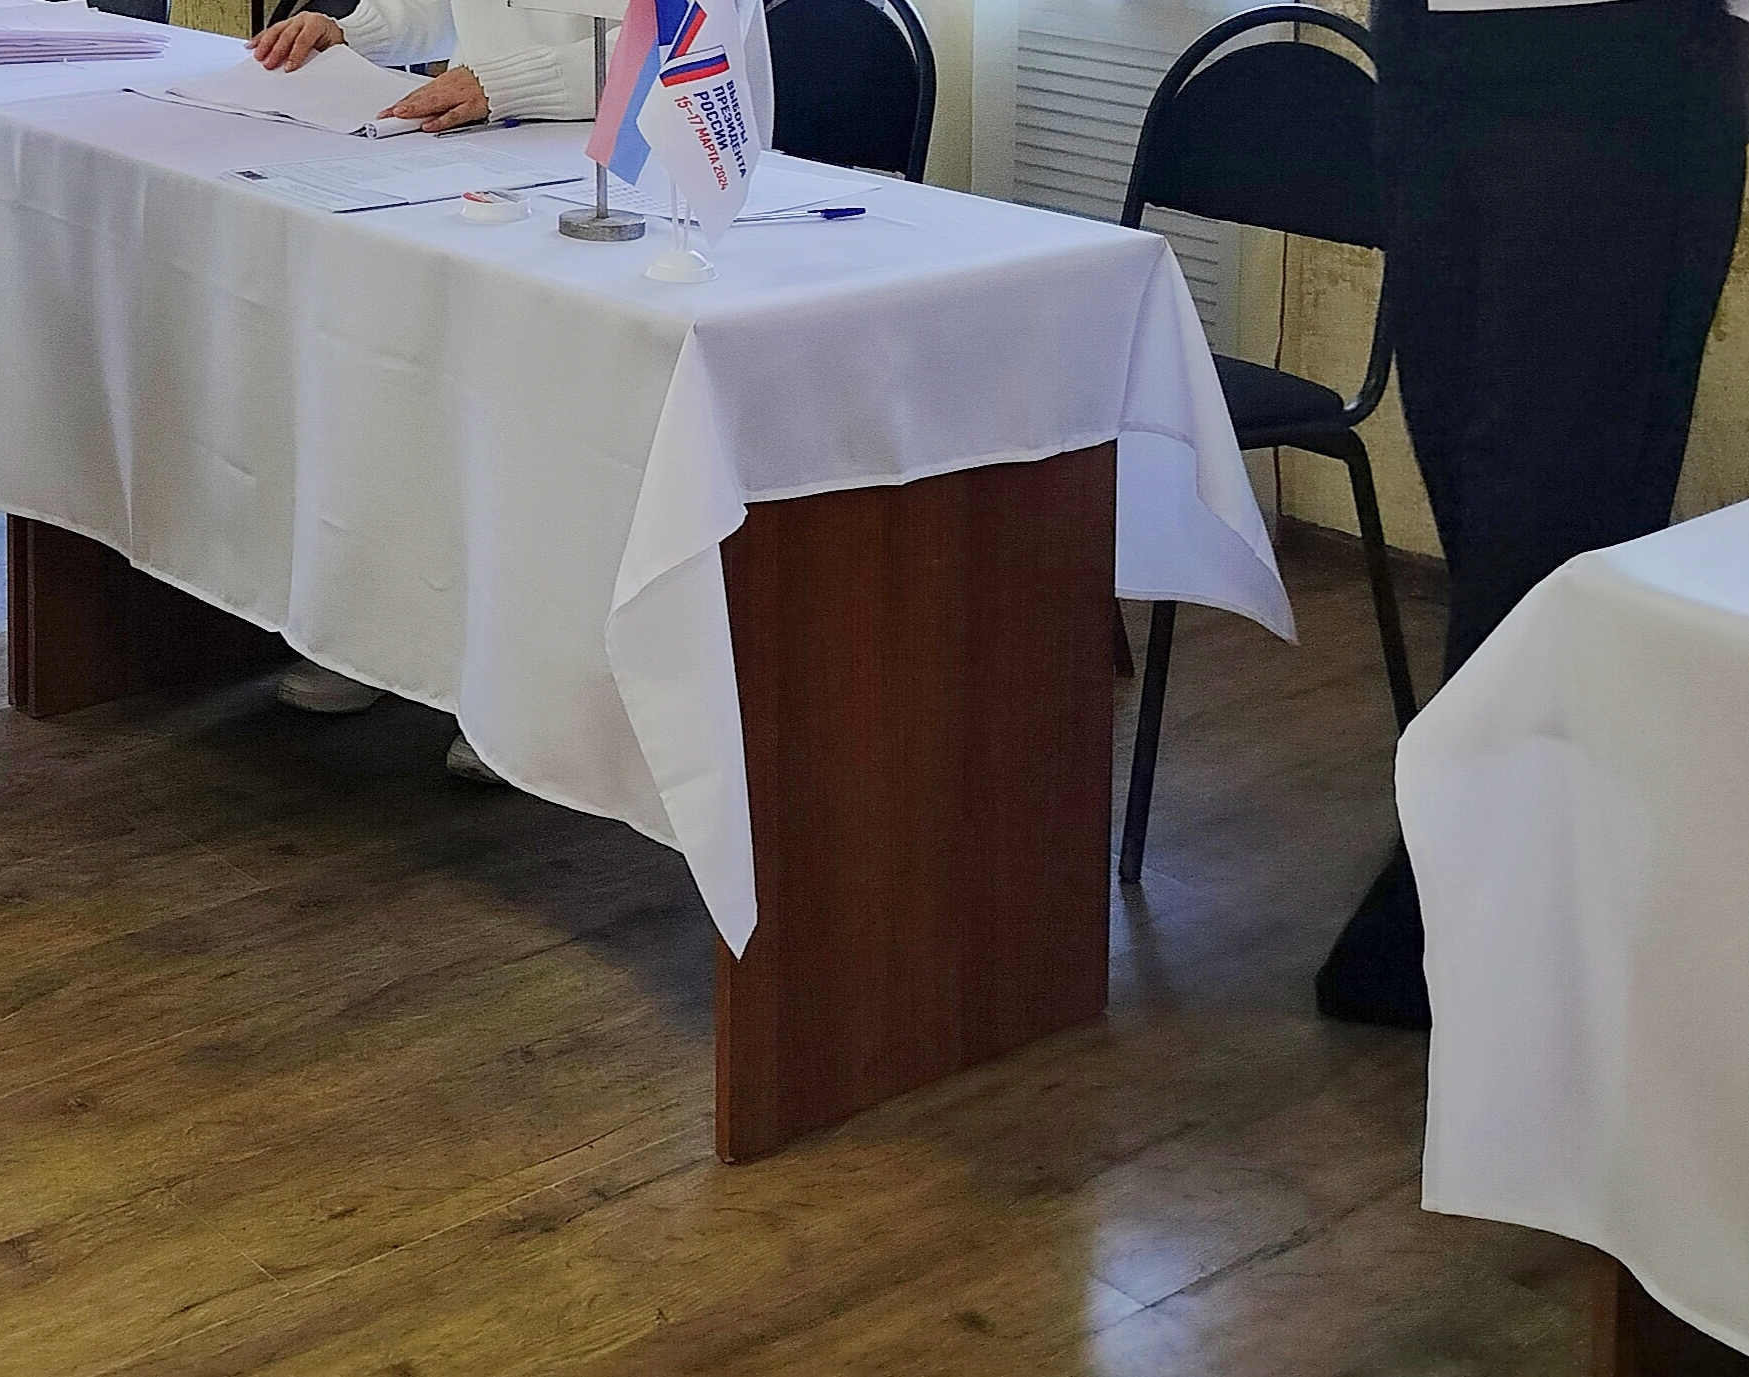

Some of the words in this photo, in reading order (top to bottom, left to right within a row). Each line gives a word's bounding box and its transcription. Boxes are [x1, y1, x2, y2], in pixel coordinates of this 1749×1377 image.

[693, 90, 729, 151] РОССИИ
[712, 85, 747, 179] ПРЕЗИДЕНТА
[726, 79, 749, 144] ВЫБОРЫ
[695, 127, 721, 165] МАРТА
[713, 164, 729, 191] 2024
